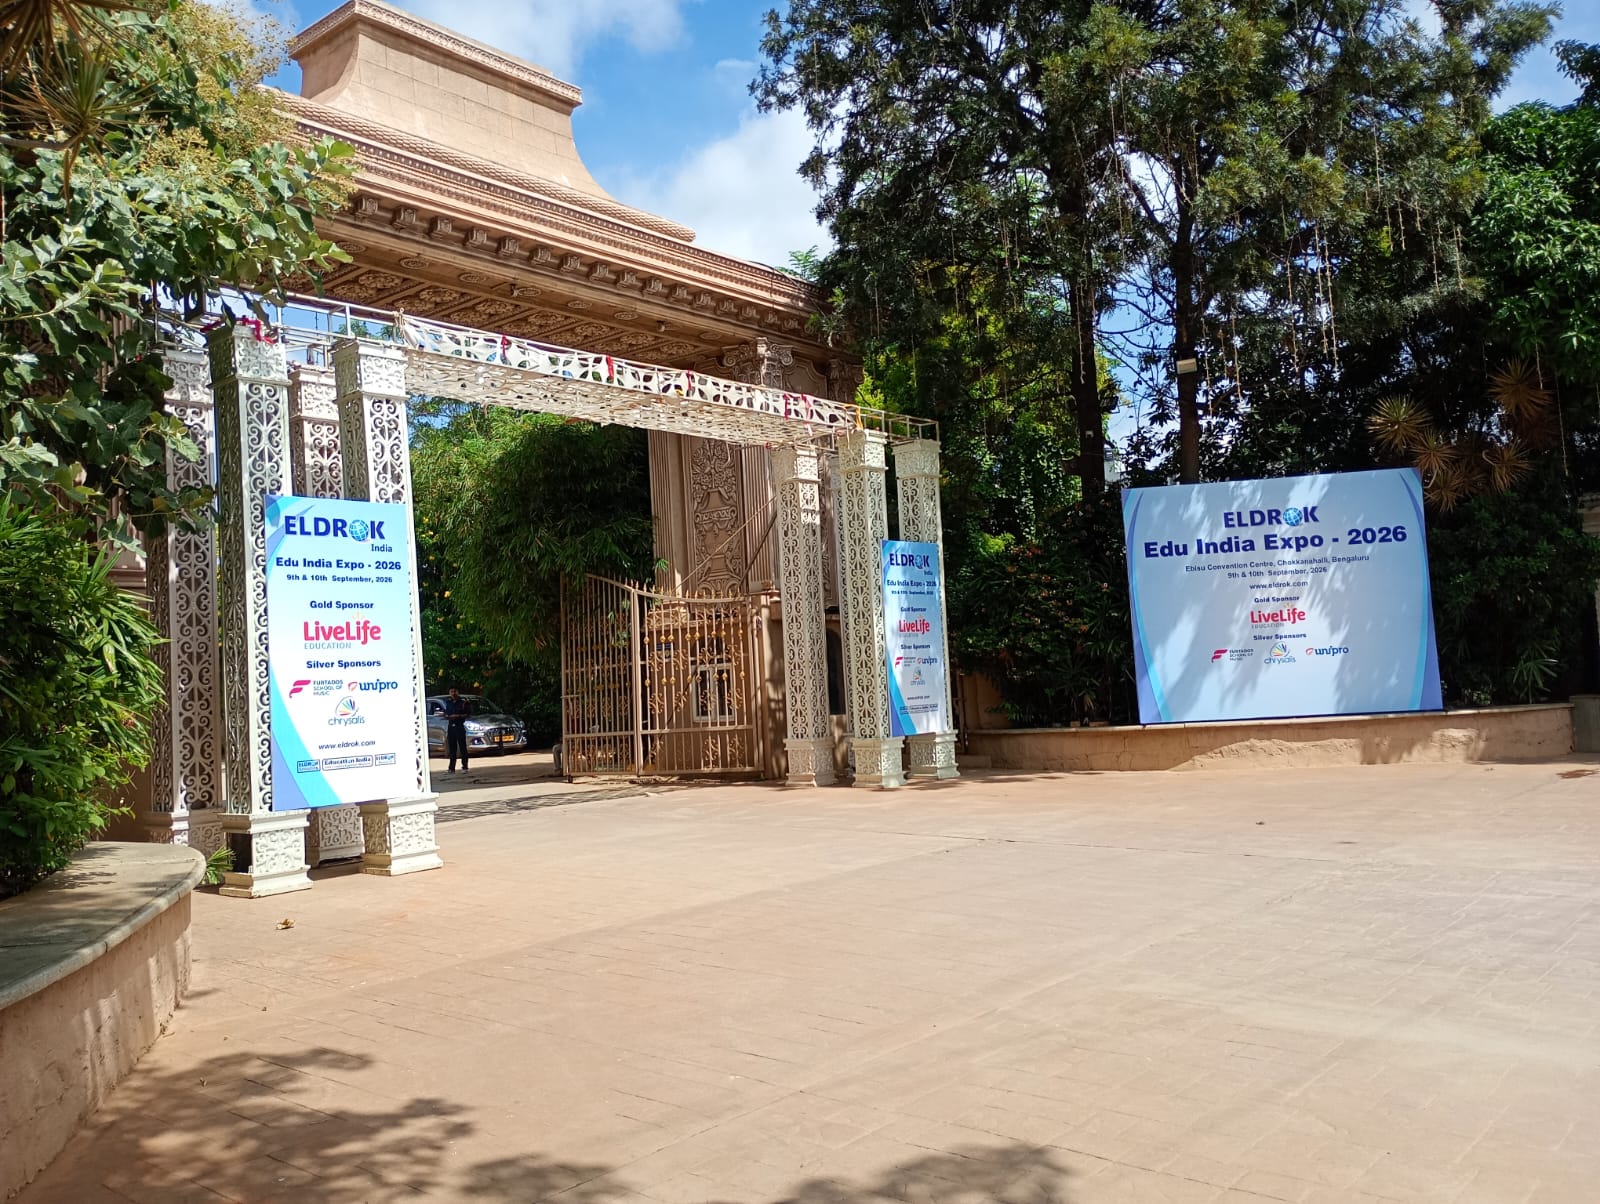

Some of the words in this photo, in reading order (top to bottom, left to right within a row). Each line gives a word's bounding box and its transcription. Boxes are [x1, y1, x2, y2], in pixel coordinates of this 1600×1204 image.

[1144, 541, 1187, 558] Edu
[1197, 536, 1255, 554] India
[1265, 534, 1323, 551] Expo
[1348, 526, 1407, 544] 2026
[371, 544, 392, 552] India
[276, 557, 298, 567] Edu
[303, 559, 332, 568] India
[337, 560, 364, 570] Expo
[375, 561, 401, 570] 2026
[1208, 563, 1248, 571] Convention
[1332, 555, 1369, 563] Bengaluru
[1268, 569, 1308, 577] September,
[332, 575, 373, 583] September,
[1250, 580, 1308, 589] www.eldrok.com
[336, 601, 373, 610] Sponsor
[1250, 608, 1306, 624] LiveLife
[899, 619, 930, 634] LiveLife
[304, 620, 380, 645] LiveLife
[1315, 646, 1349, 656] unipro
[338, 660, 381, 669] Sponsors
[1264, 656, 1296, 664] chrysalis
[359, 679, 398, 693] unipro
[328, 715, 365, 726] chrysalis
[319, 740, 375, 749] www.eldrok.com
